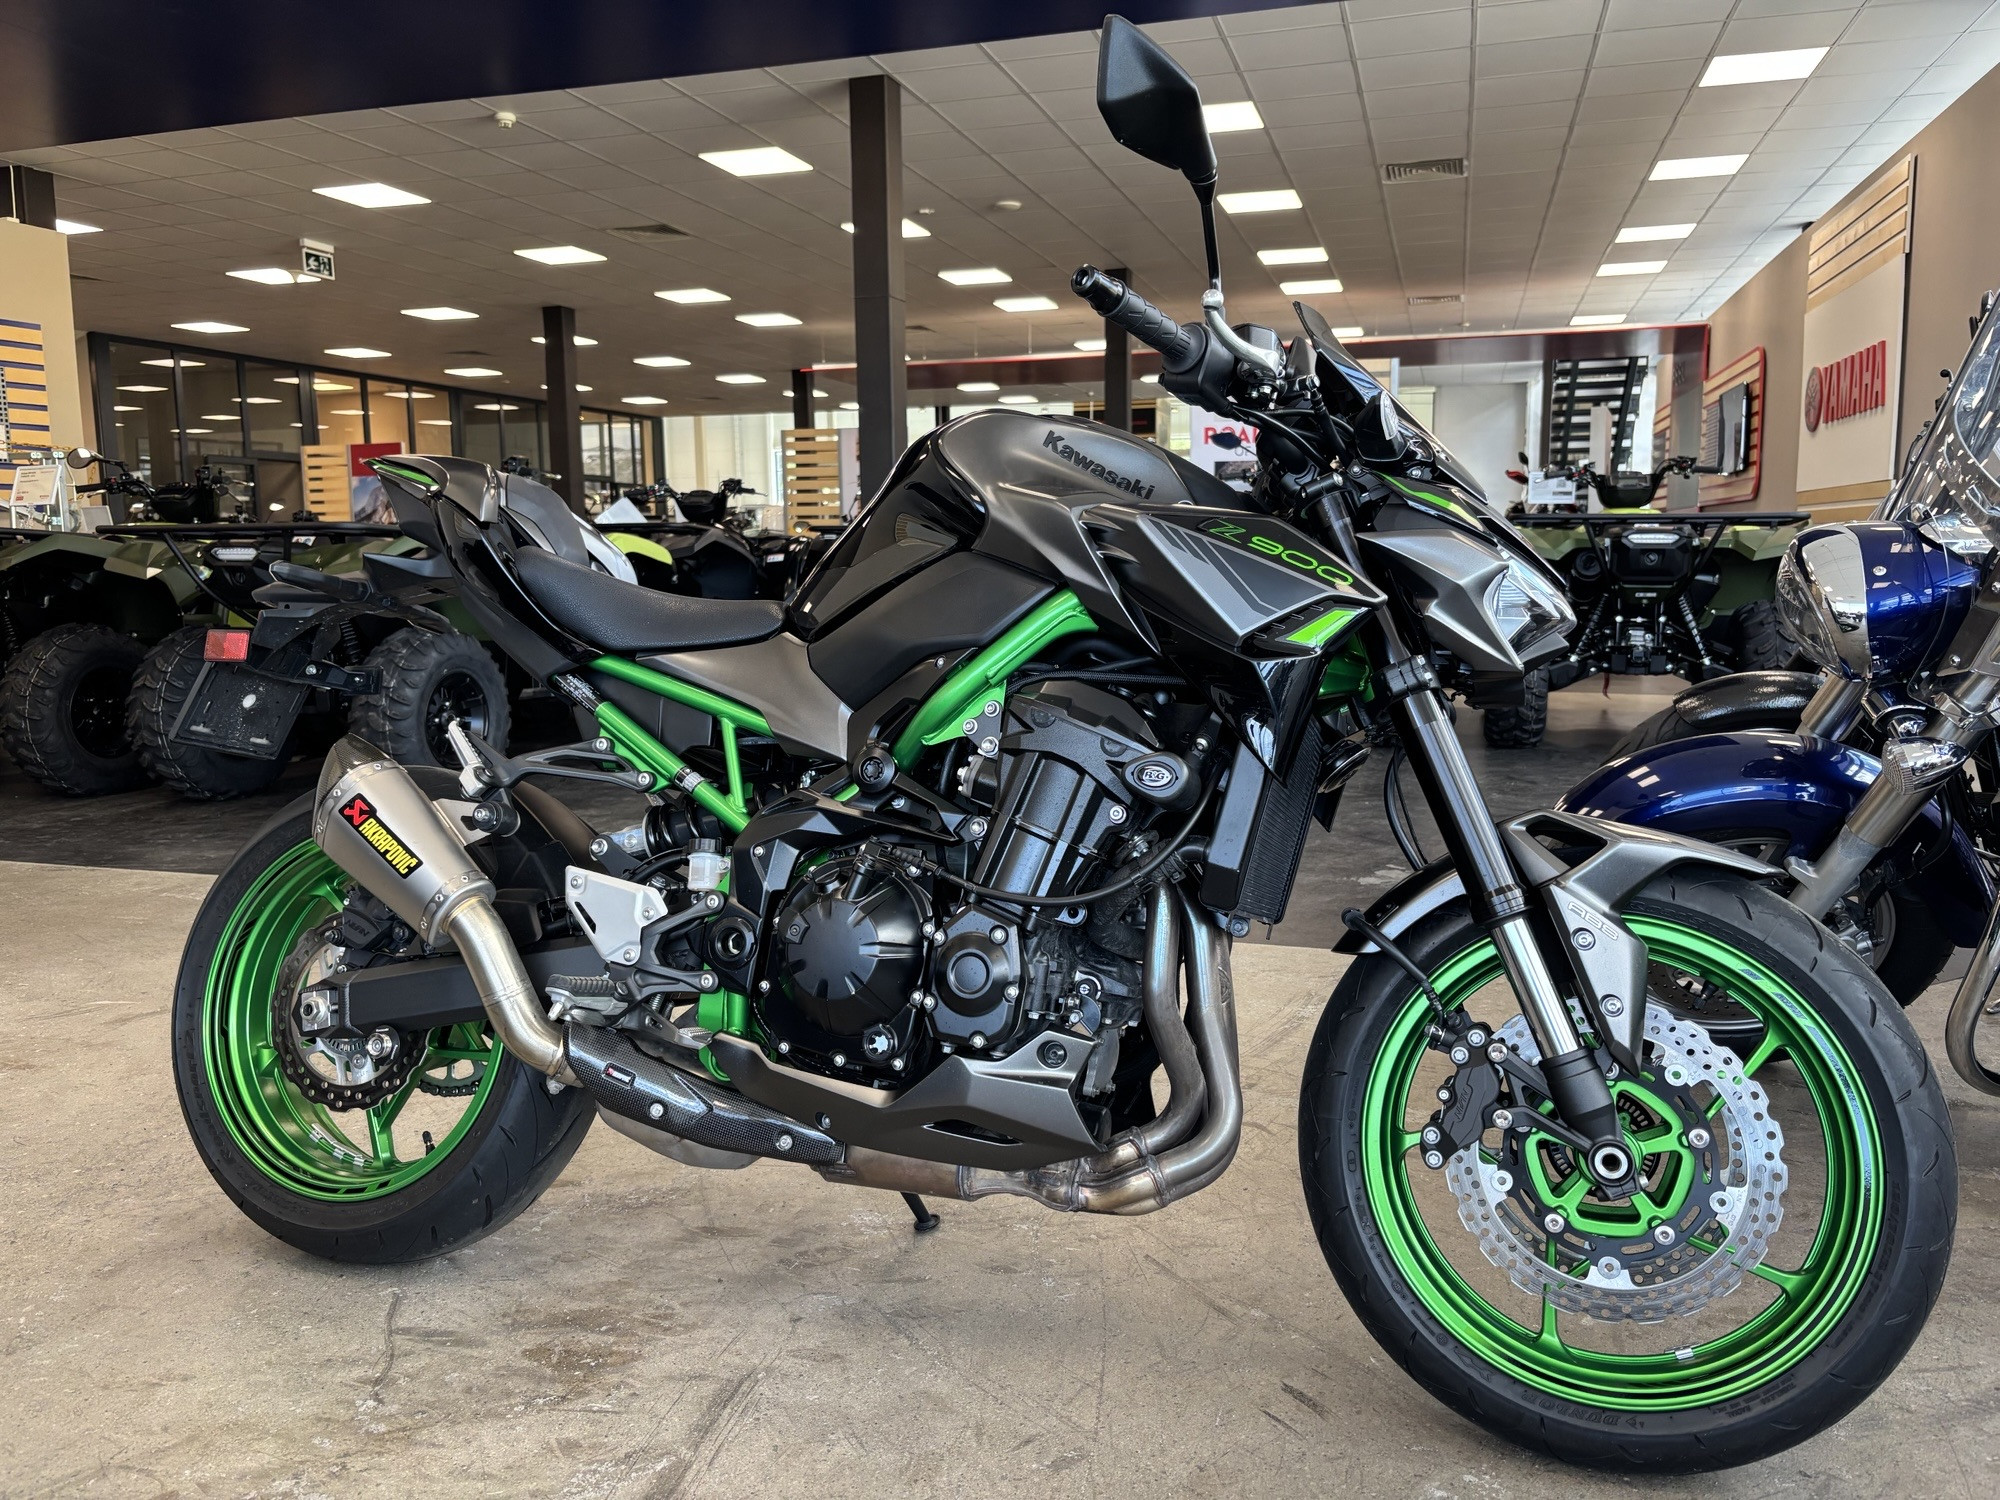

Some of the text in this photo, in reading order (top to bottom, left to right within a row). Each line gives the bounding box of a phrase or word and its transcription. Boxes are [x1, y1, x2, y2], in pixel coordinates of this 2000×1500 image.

[1821, 340, 1886, 424] YAMAHA
[1203, 426, 1260, 445] RA
[1043, 430, 1155, 500] Kawasaki
[1568, 901, 1619, 941] ABS
[1520, 1391, 1621, 1427] DUNLOP
